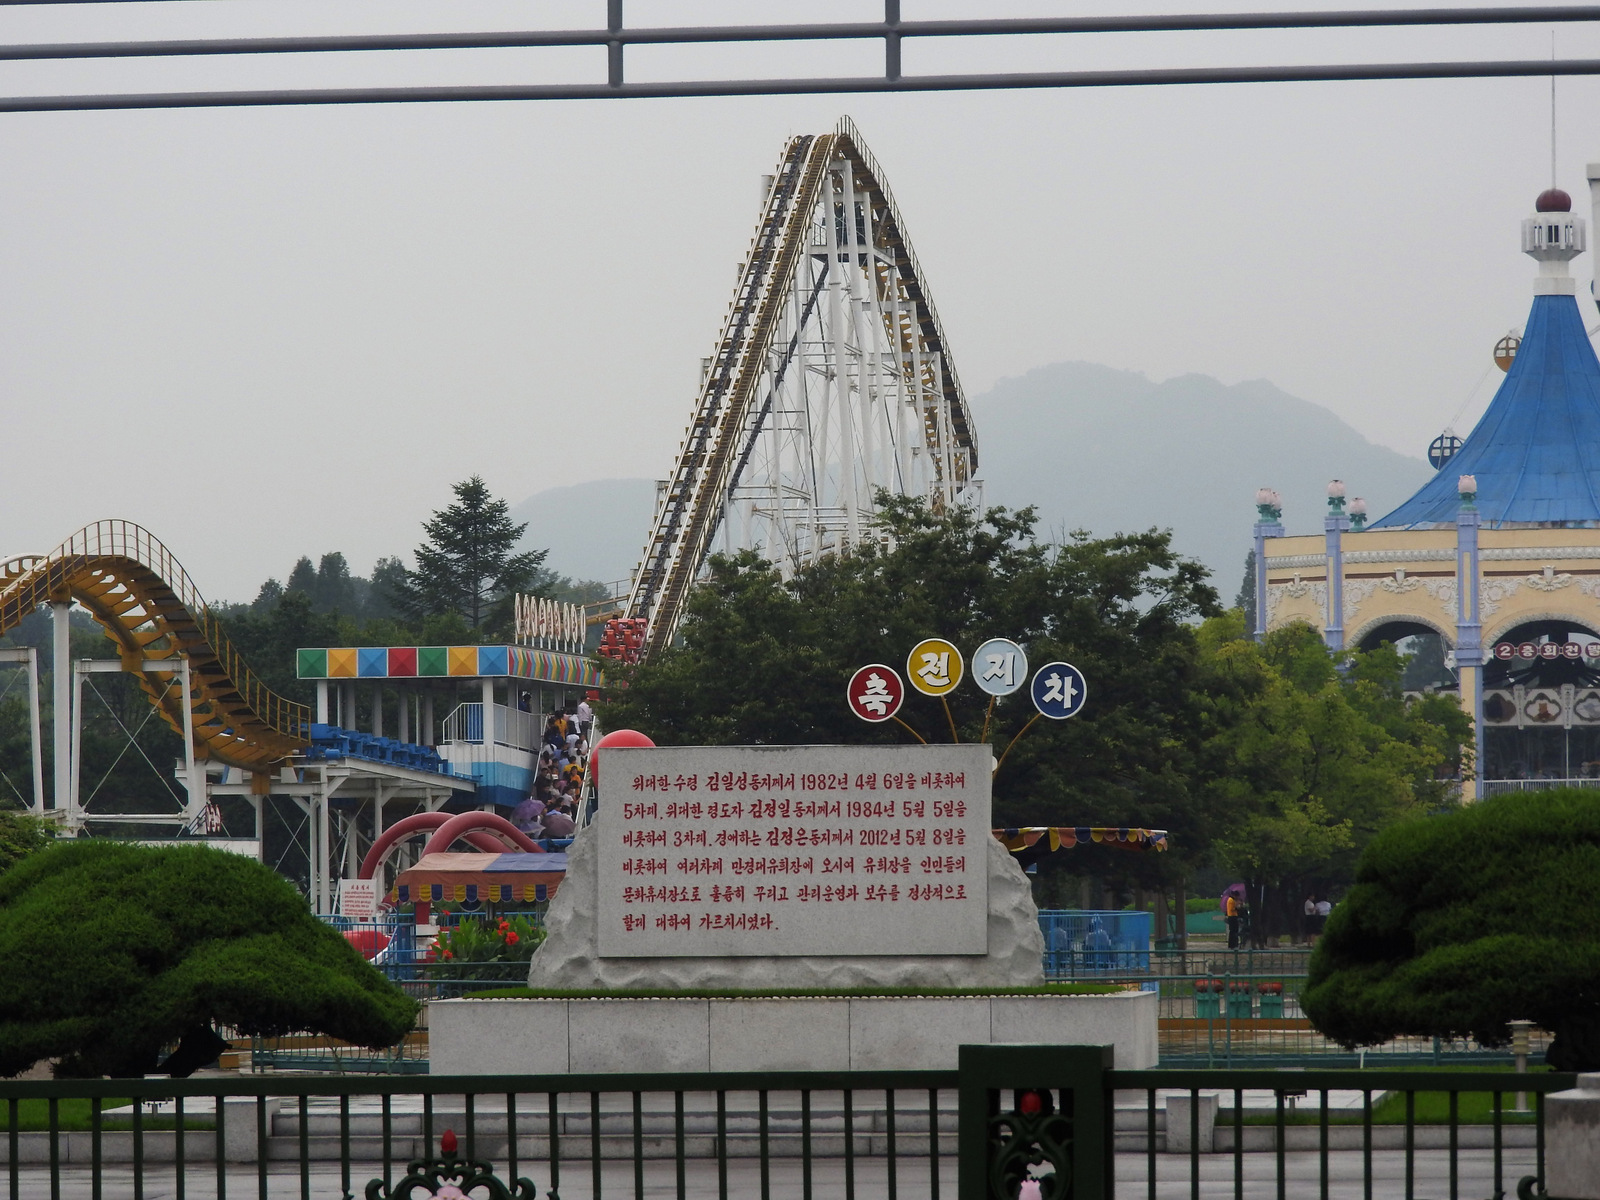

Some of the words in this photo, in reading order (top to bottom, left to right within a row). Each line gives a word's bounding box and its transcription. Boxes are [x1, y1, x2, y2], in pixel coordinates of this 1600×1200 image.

[632, 775, 670, 792] 위대한
[674, 774, 698, 792] 수령
[800, 773, 849, 791] 1982년
[854, 773, 878, 791] 4월
[882, 773, 917, 791] 6일을
[920, 772, 966, 790] 비롯하여
[666, 802, 703, 820] 위대한
[707, 802, 744, 820] 령도자
[846, 801, 896, 819] 1984년
[902, 800, 926, 819] 5월
[933, 800, 968, 819] 5일을
[622, 830, 667, 847] 비롯하여
[717, 830, 761, 847] 경애하는
[859, 829, 901, 846] 2012년
[905, 829, 926, 847] 5월
[932, 828, 966, 846] 8일을
[622, 858, 667, 875] 비롯하여
[677, 857, 723, 875] 여러차례
[730, 857, 814, 876] 만경대유희장에
[822, 857, 855, 874] 오시여
[863, 856, 911, 874] 유희장을
[919, 856, 966, 875] 인민들의
[623, 885, 701, 904] 문화휴식장소로
[709, 885, 745, 904] 훌륭히
[753, 885, 789, 902] 꾸리고
[796, 885, 859, 903] 관리운영과
[865, 884, 900, 902] 보수를
[909, 884, 967, 902] 정상적으로
[622, 914, 646, 932] 할데
[655, 914, 691, 931] 대하여
[700, 913, 779, 932] 가르치시였다.
